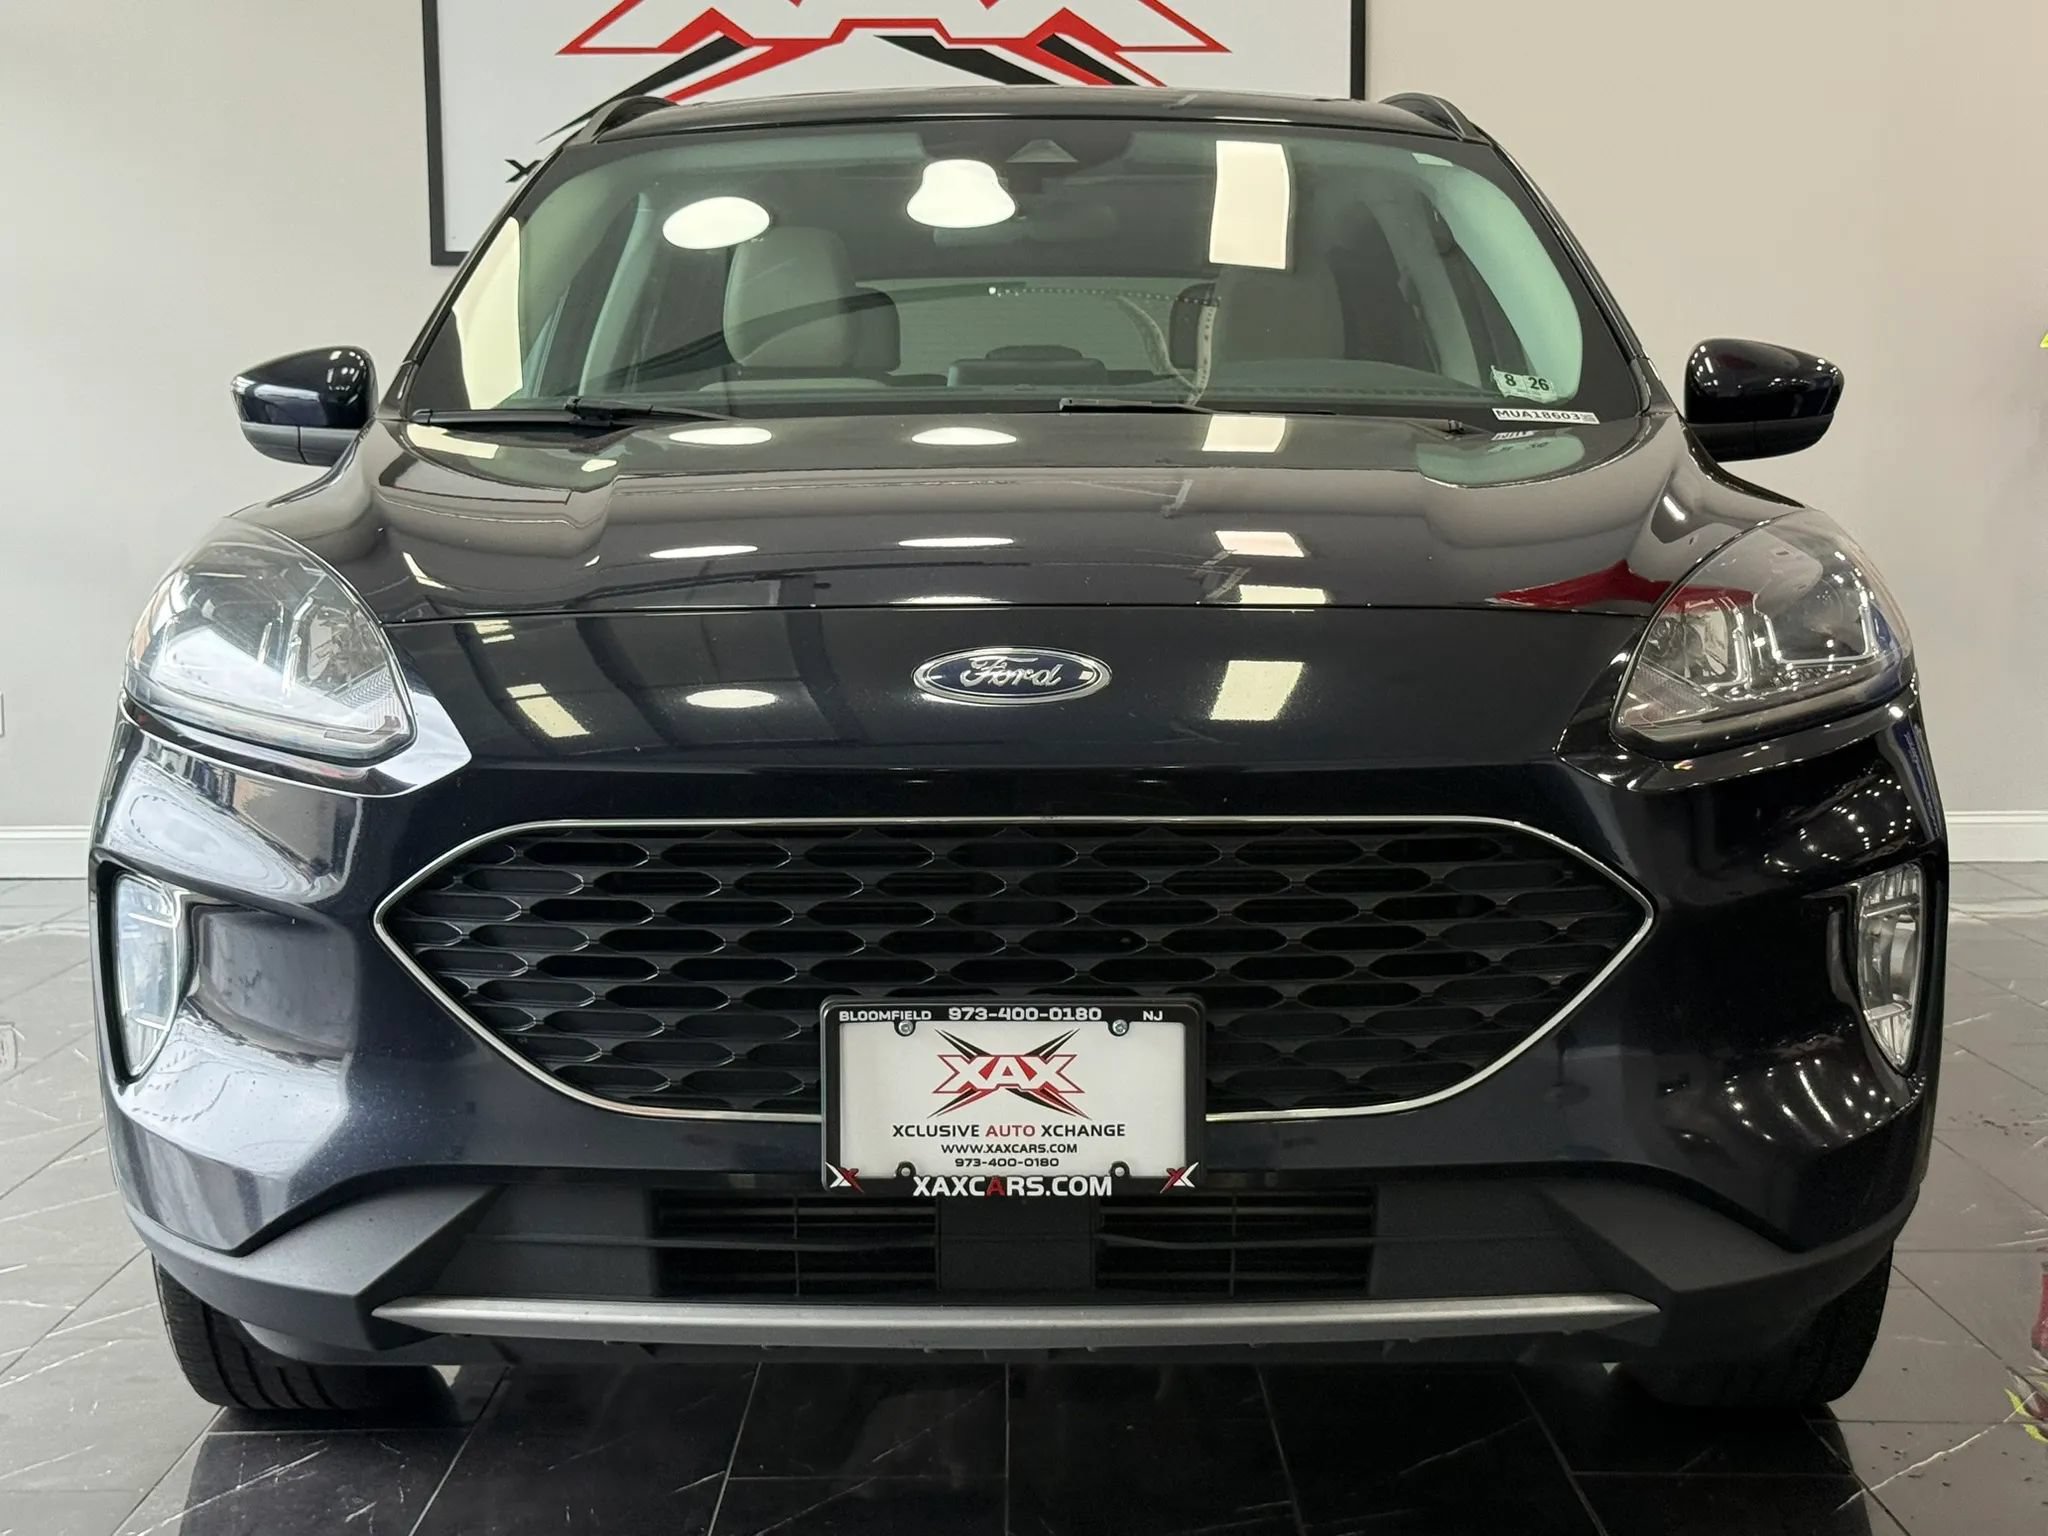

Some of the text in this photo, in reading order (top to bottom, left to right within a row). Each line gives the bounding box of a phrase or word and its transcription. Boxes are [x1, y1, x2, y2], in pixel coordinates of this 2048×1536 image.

[1504, 373, 1550, 391] 8 26
[1495, 410, 1581, 420] MUA18603
[960, 655, 1064, 687] Ford
[839, 1007, 1164, 1022] BLOOMFIELD 973-400-0180 NJ
[892, 1123, 1126, 1138] XCLUSIVE AUTO XCHANGE
[941, 1143, 1078, 1154] WWW.XAXCARS.COM
[955, 1157, 1060, 1168] 973-400-0180
[913, 1176, 1112, 1197] XAXCARS.COM
